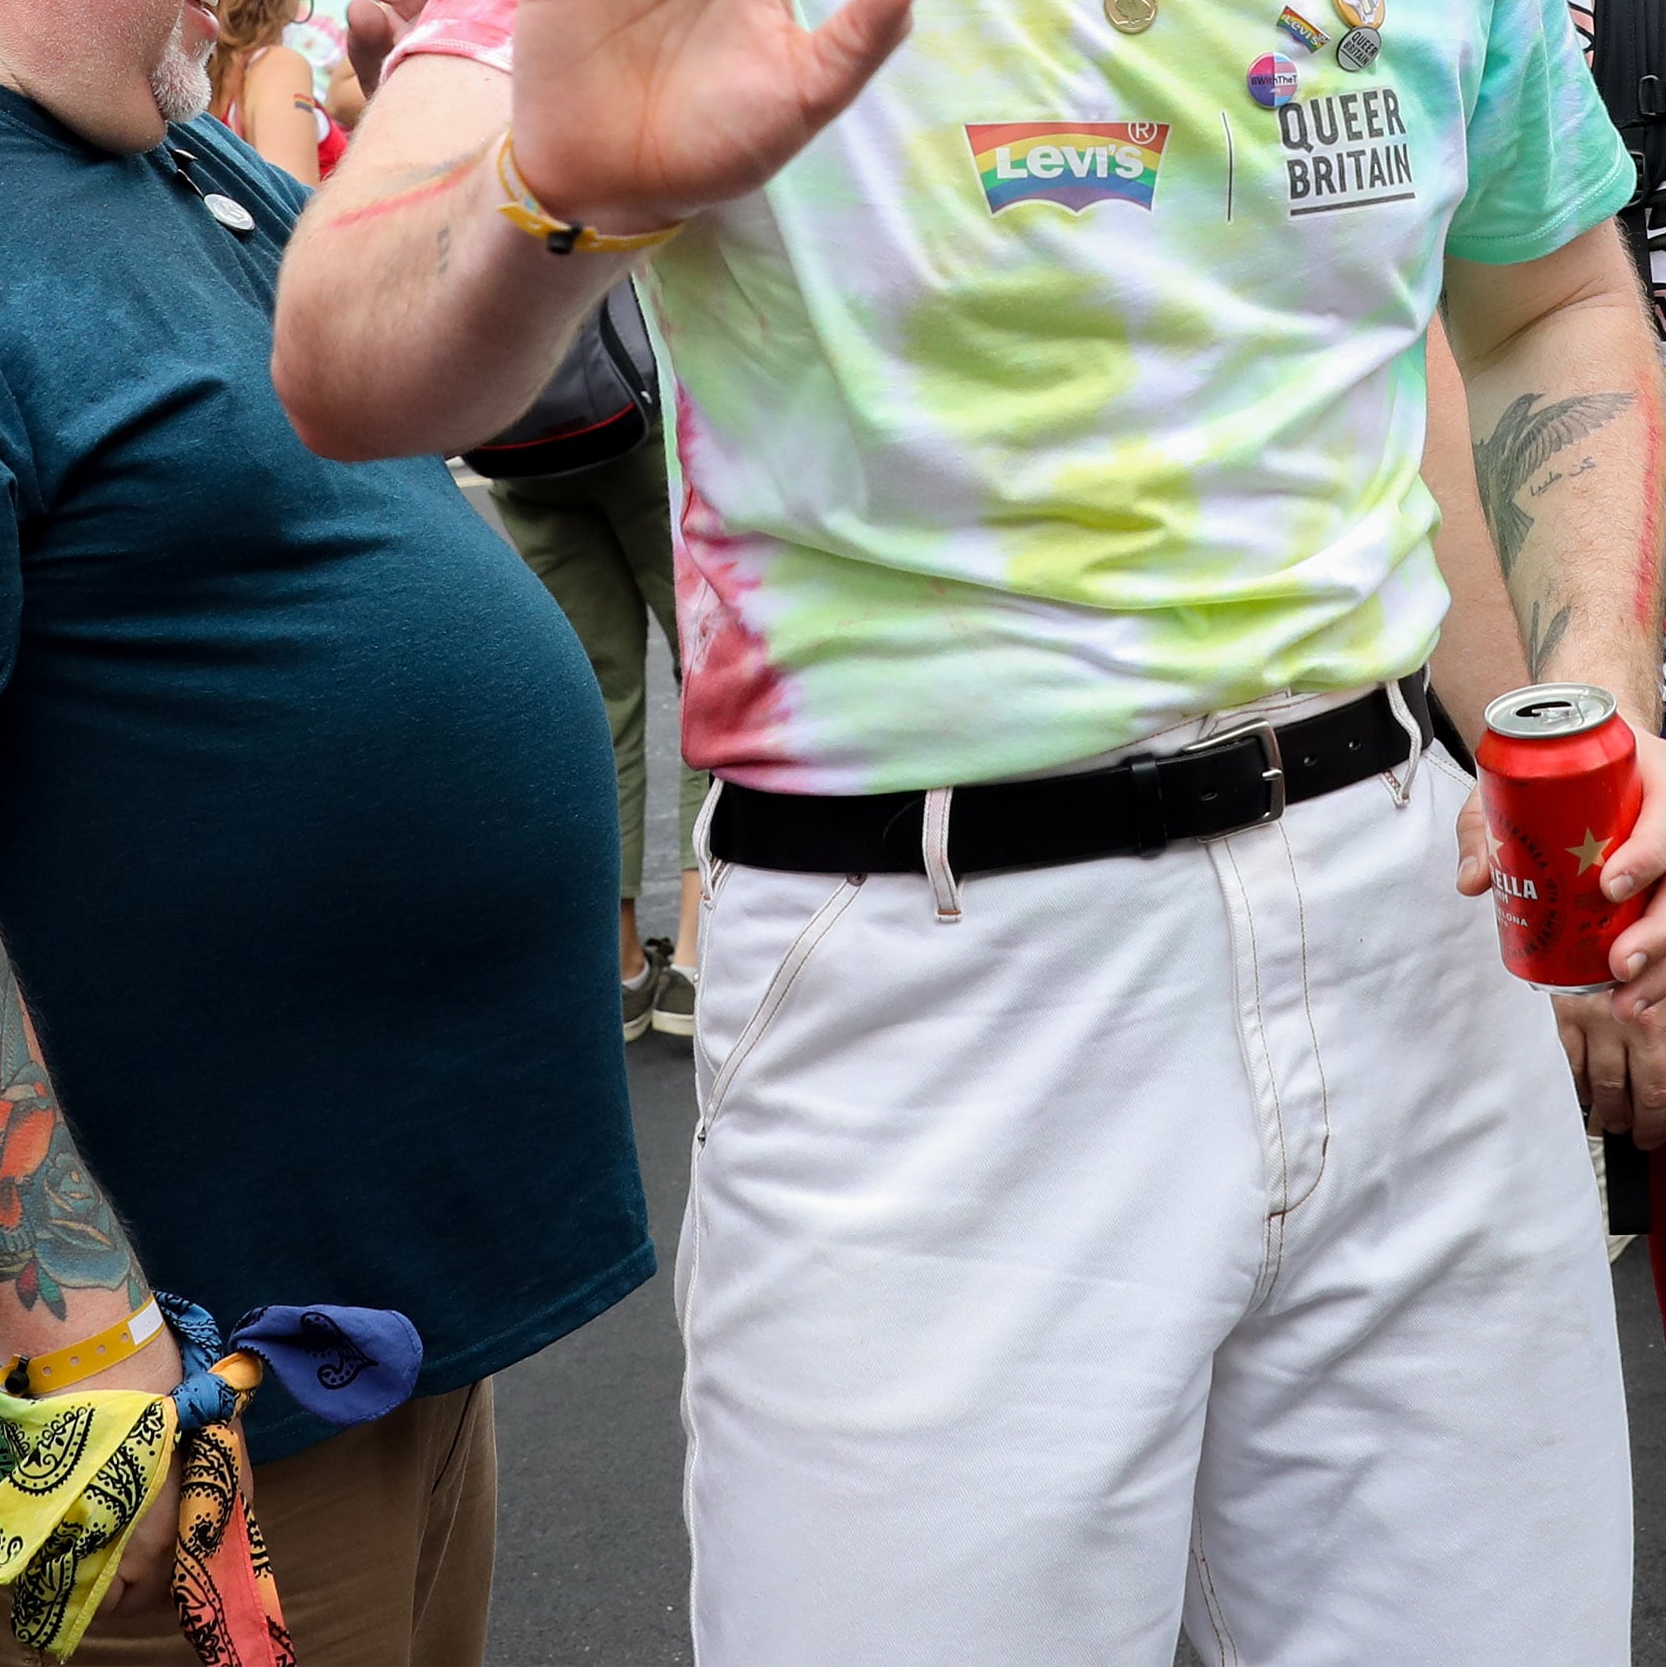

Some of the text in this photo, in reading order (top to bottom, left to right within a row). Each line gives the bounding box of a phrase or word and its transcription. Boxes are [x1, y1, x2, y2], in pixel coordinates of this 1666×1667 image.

[1342, 39, 1371, 67] BRITAIN
[1351, 30, 1379, 58] QUEER
[1278, 88, 1407, 154] QUEER
[995, 144, 1145, 180] Levi's
[1286, 143, 1413, 201] BRITAIN
